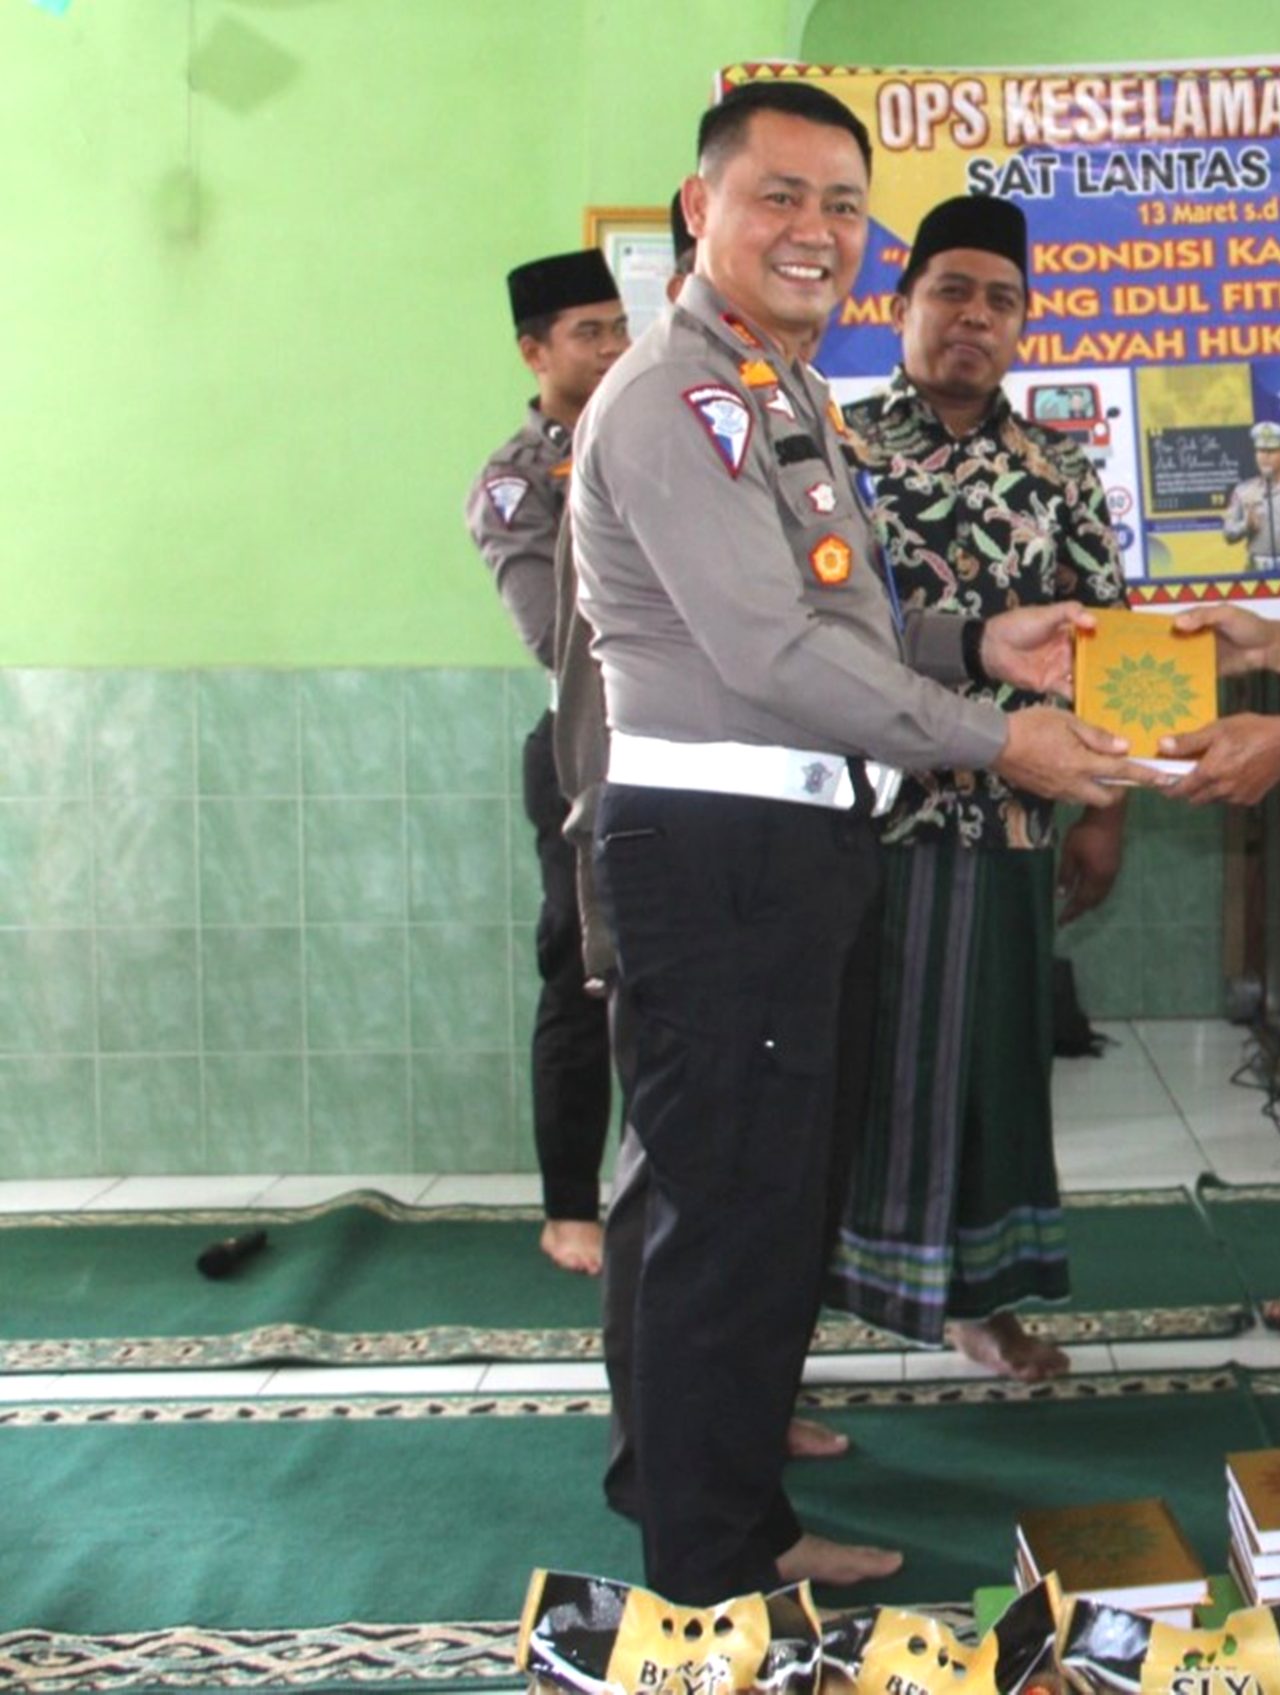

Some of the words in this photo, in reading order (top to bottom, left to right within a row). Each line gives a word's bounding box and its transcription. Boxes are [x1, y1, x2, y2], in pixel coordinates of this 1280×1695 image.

[877, 78, 990, 150] OPS
[966, 153, 1058, 197] SAT
[1075, 147, 1269, 194] LANTAS
[1138, 202, 1166, 226] 13
[1171, 201, 1238, 225] Maret
[1245, 199, 1279, 222] s.d
[1031, 238, 1215, 275] KONDISI
[1111, 283, 1210, 317] IDUL
